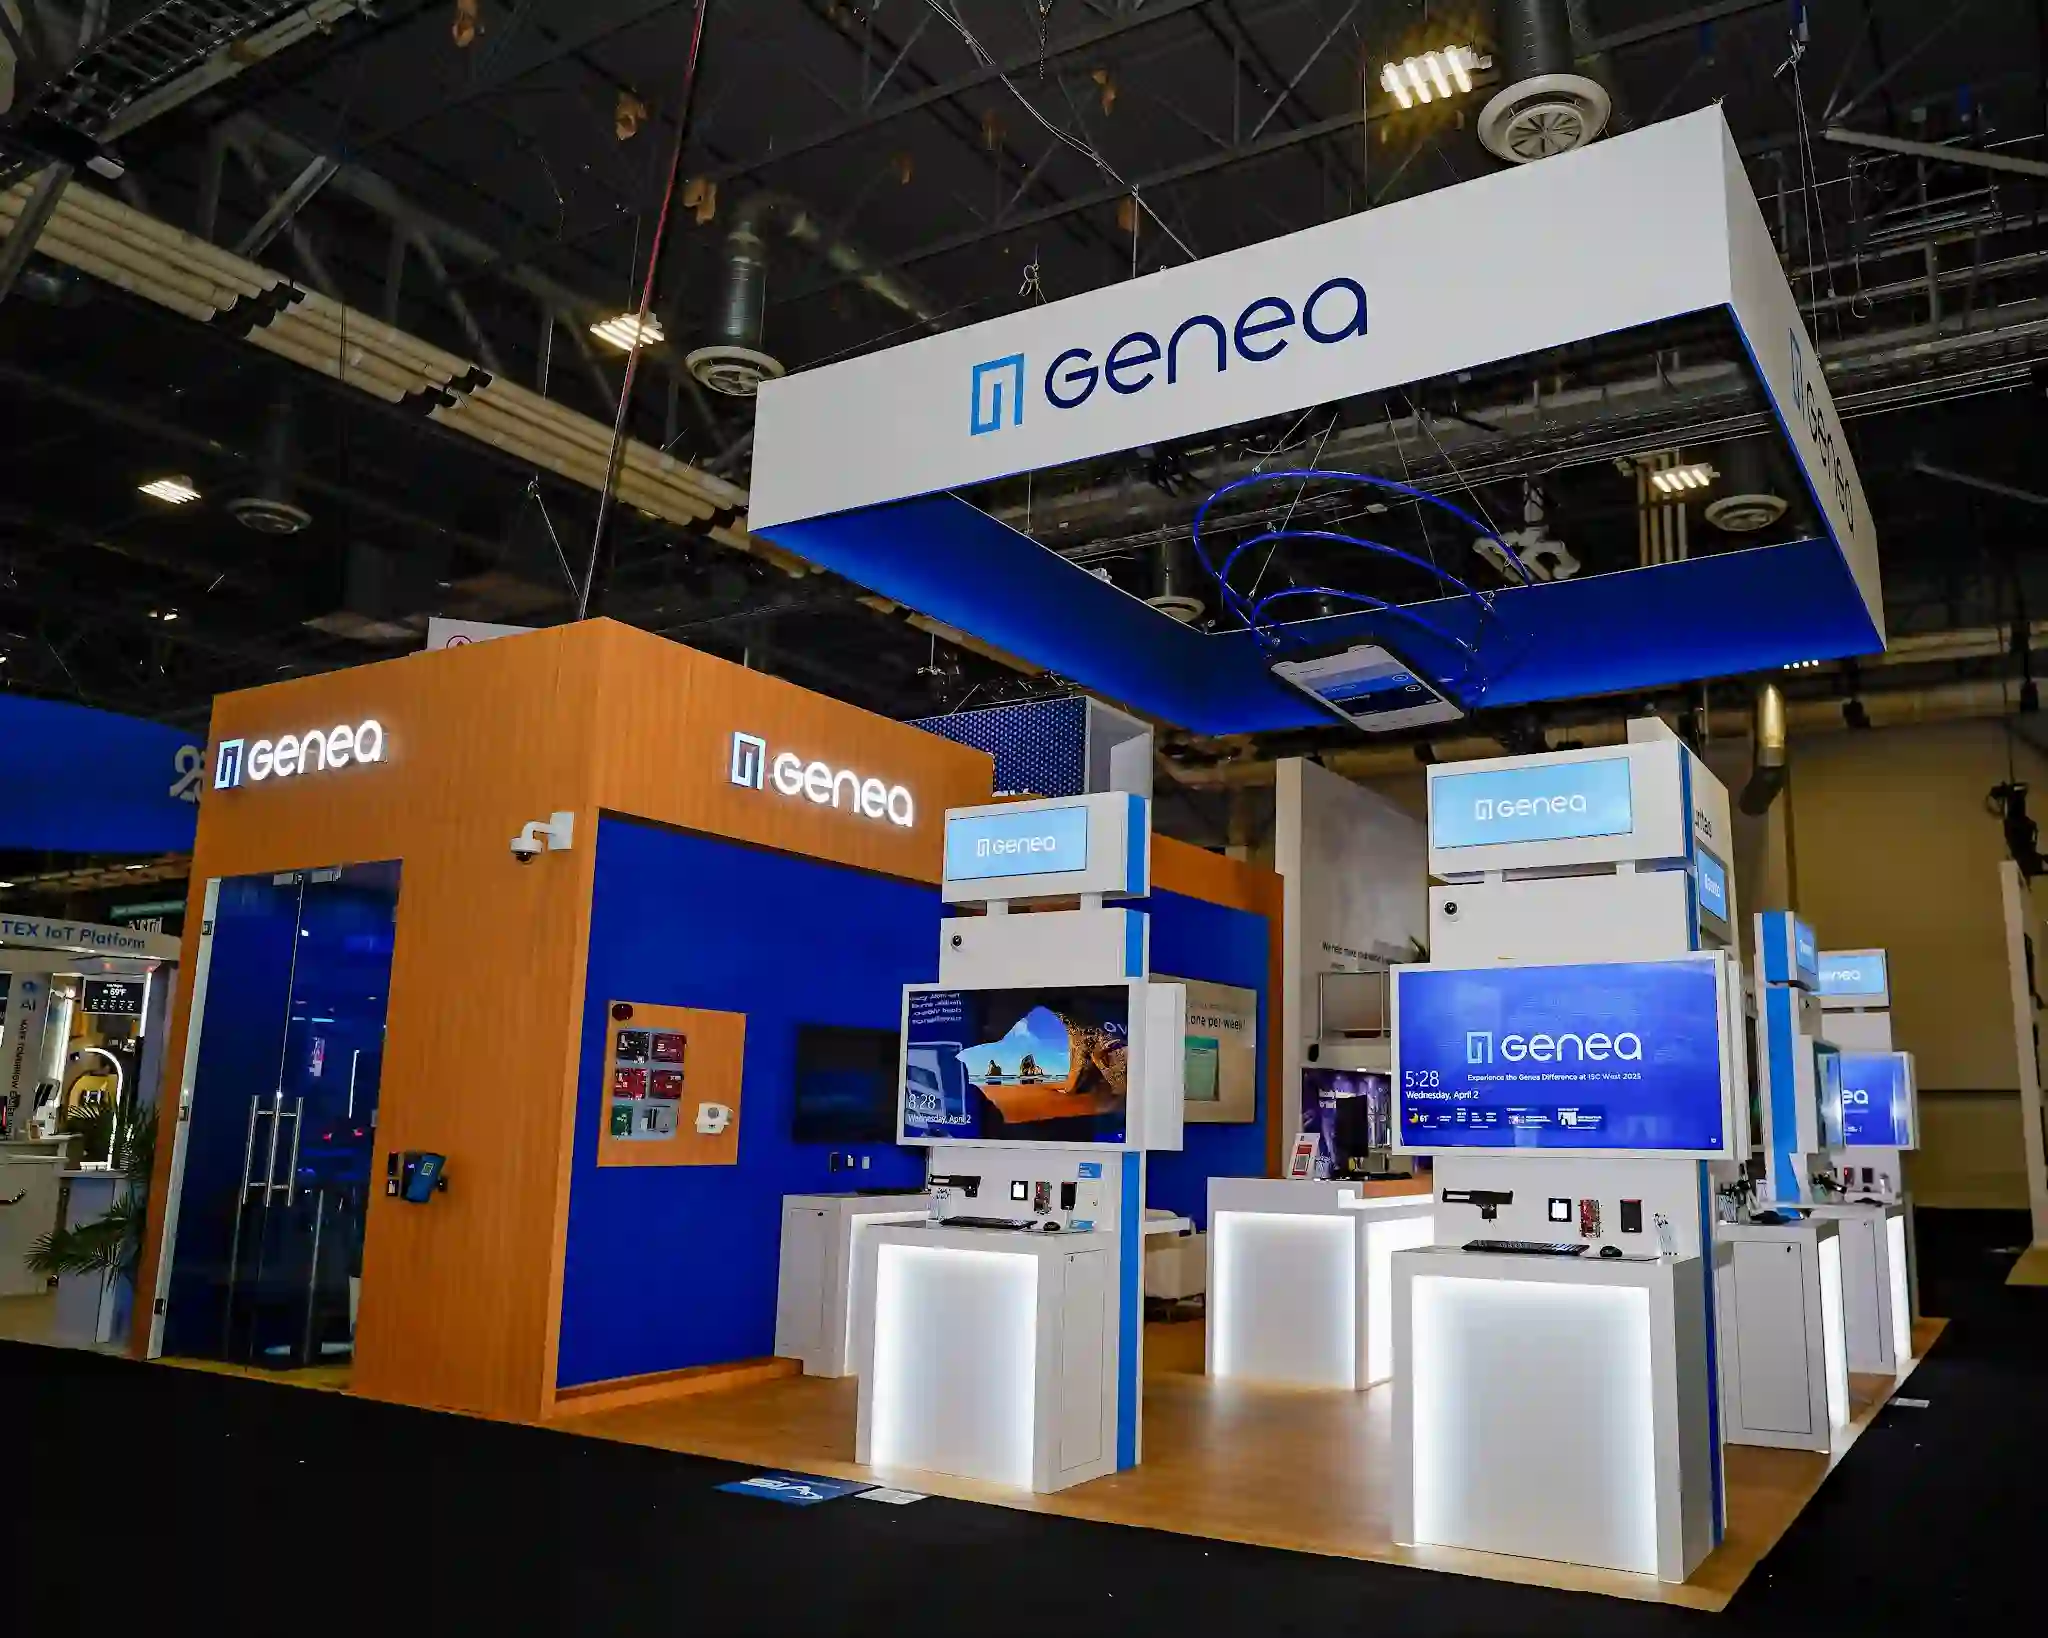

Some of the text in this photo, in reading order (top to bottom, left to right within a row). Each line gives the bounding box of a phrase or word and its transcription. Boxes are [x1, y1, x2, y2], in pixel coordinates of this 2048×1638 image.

[1044, 277, 1368, 409] Genea
[247, 719, 383, 781] Genea
[773, 752, 914, 828] Genea
[1497, 793, 1587, 818] Genea
[992, 836, 1056, 856] Genea
[45, 925, 75, 941] IoT
[80, 928, 146, 949] Platform
[1501, 1032, 1642, 1062] Genea
[1405, 1070, 1440, 1088] 5:28
[1467, 1074, 1504, 1082] Experience
[908, 1093, 936, 1110] 8:28
[1453, 1090, 1472, 1100] April
[1473, 1090, 1479, 1099] 2
[966, 1114, 972, 1124] 2
